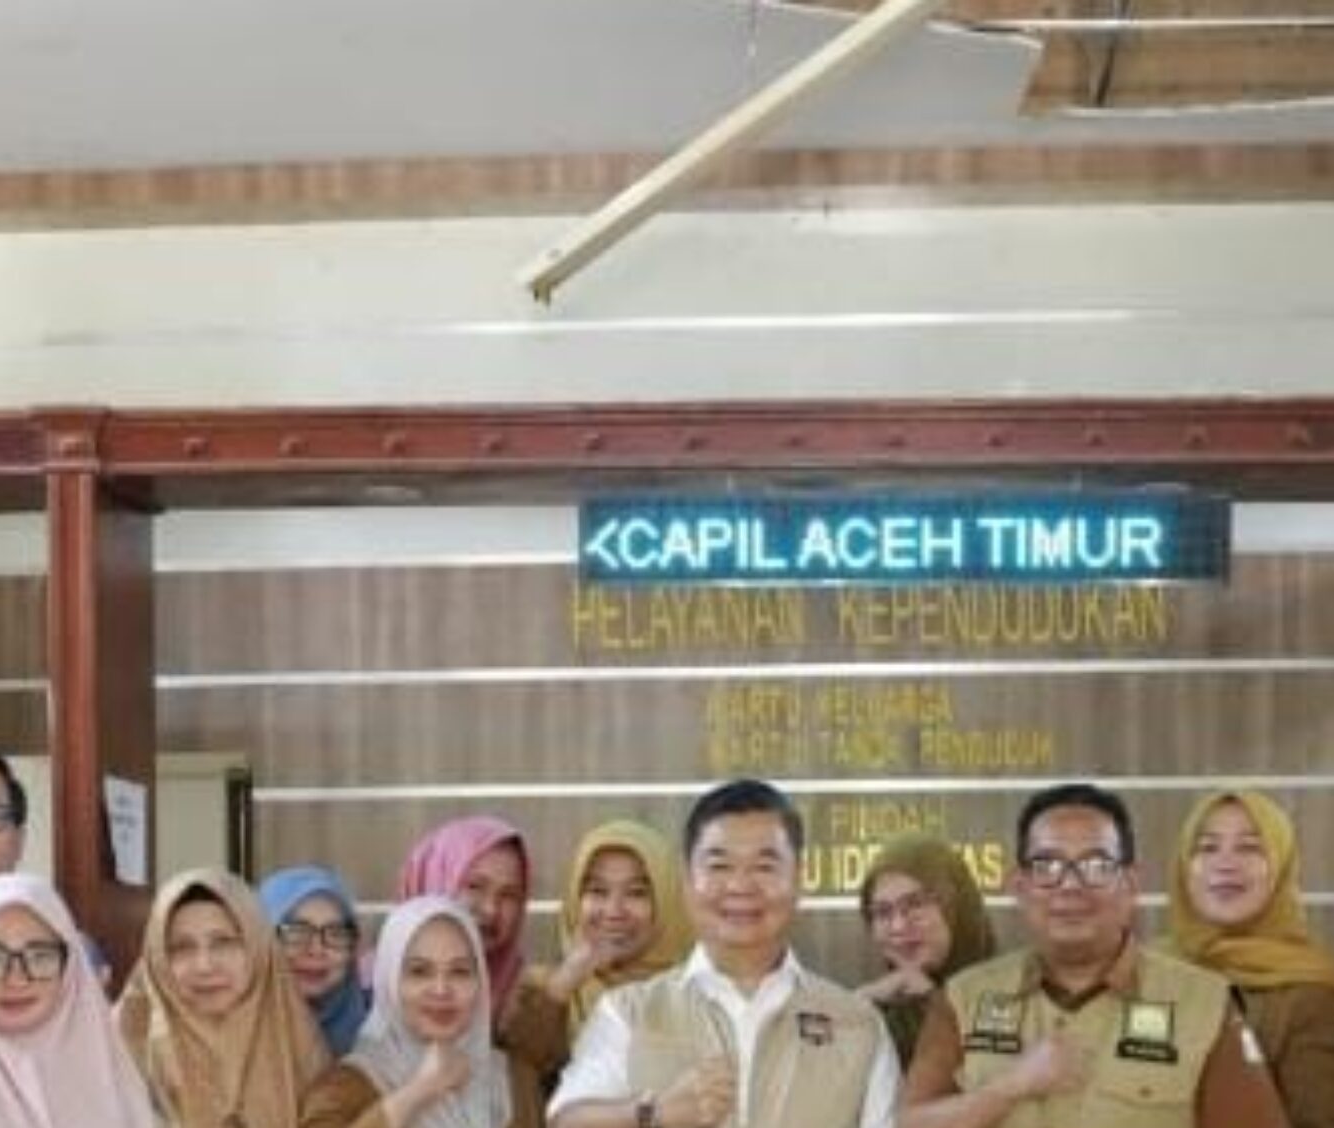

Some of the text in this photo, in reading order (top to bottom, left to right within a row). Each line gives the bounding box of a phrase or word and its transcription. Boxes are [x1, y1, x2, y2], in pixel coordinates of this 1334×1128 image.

[796, 516, 960, 568] ACEH
[977, 516, 1164, 568] TIMUR
[573, 586, 804, 650] PELAYANAN
